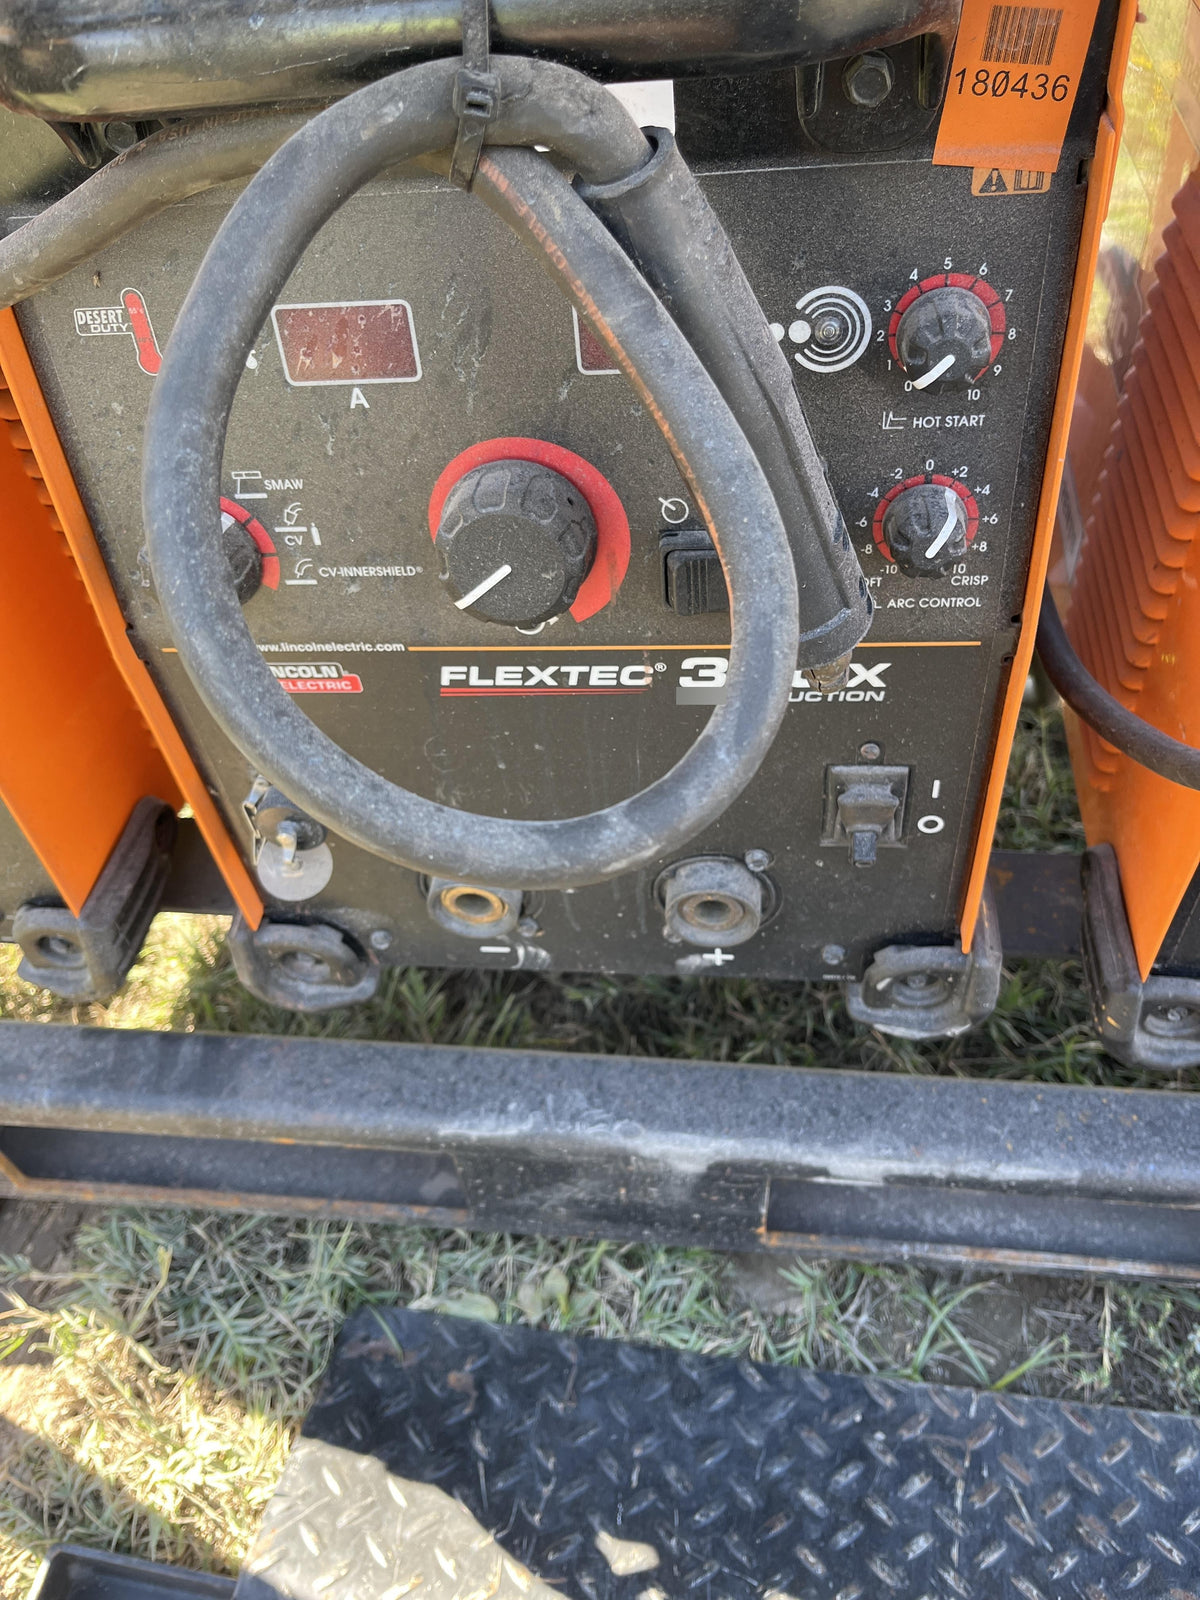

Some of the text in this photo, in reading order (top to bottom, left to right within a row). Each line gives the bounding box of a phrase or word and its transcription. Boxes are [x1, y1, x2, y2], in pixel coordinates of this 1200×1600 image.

[954, 67, 1071, 102] 180436
[943, 257, 952, 270] 5
[978, 262, 988, 276] 6
[909, 268, 919, 281] 4
[1005, 289, 1014, 302] 7
[883, 299, 892, 312] 3
[77, 309, 123, 325] DESERT
[90, 322, 129, 333] DUTY
[876, 330, 885, 342] 2
[1007, 328, 1017, 340] 8
[887, 359, 892, 371] 1
[993, 364, 1002, 377] 9
[904, 380, 912, 392] 0
[350, 387, 371, 409] A
[967, 389, 981, 400] 10
[913, 414, 986, 429] HOT START
[925, 459, 935, 471] 0
[889, 468, 903, 480] -2
[951, 466, 969, 478] +2
[264, 478, 304, 490] SMAW
[974, 484, 991, 496] +4
[866, 487, 879, 498] -4
[855, 516, 868, 528] -6
[981, 513, 999, 525] +6
[284, 535, 303, 546] CV
[971, 541, 988, 552] +8
[860, 543, 873, 555] -8
[879, 564, 898, 575] -10
[950, 575, 989, 586] CRISP
[886, 597, 982, 609] ARC CONTROL
[256, 642, 405, 652] ww.lincolnelectric.com
[269, 665, 339, 679] NCOLN
